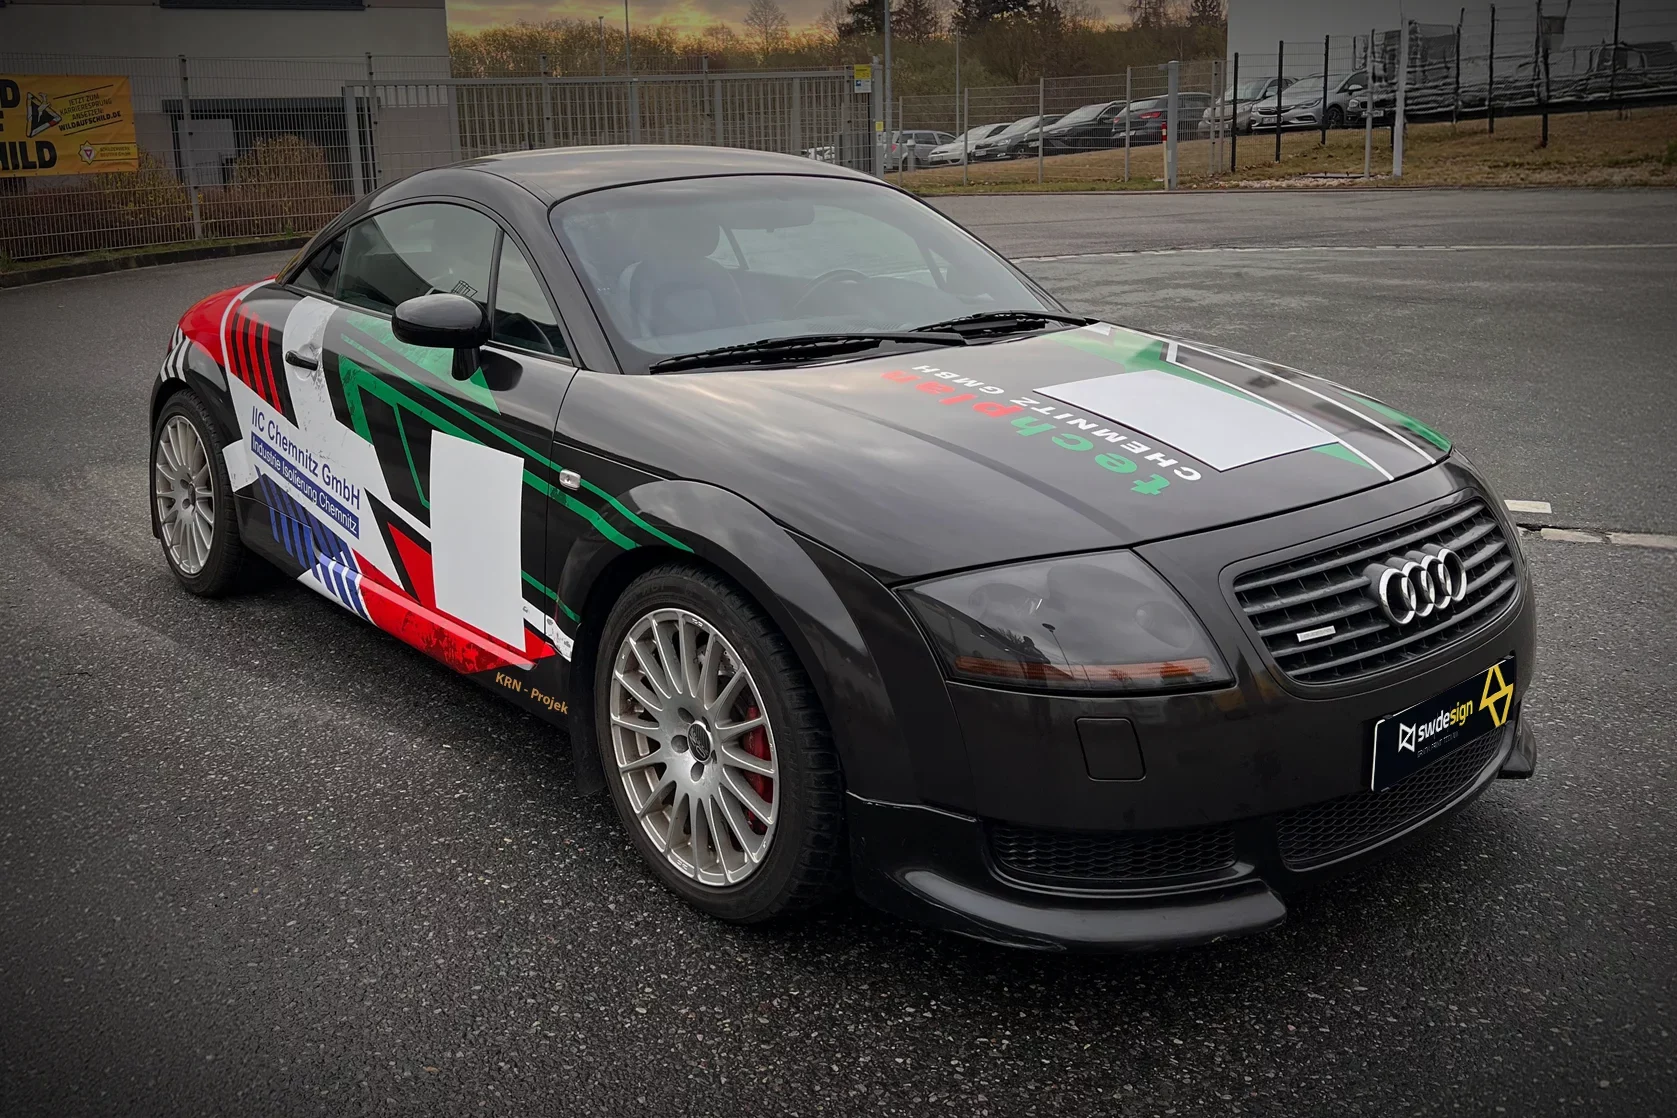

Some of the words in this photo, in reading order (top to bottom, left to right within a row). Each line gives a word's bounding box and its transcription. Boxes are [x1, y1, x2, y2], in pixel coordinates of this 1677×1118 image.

[59, 110, 121, 131] WILDAUFSCHILD.DE
[60, 98, 112, 115] KARRIERESPRUNG
[68, 96, 85, 106] JETZT
[86, 92, 100, 102] ZUM
[911, 364, 1005, 395] GMBH
[1009, 396, 1202, 481] CHEMNITZ
[252, 435, 281, 471] Industrie
[282, 460, 318, 505] Isolierung
[319, 491, 357, 534] Chemnitz
[267, 420, 319, 477] Chemnitz
[321, 463, 360, 510] GmbH
[495, 671, 522, 692] KRN
[530, 687, 569, 715] Projek
[1417, 700, 1474, 743] swdesign
